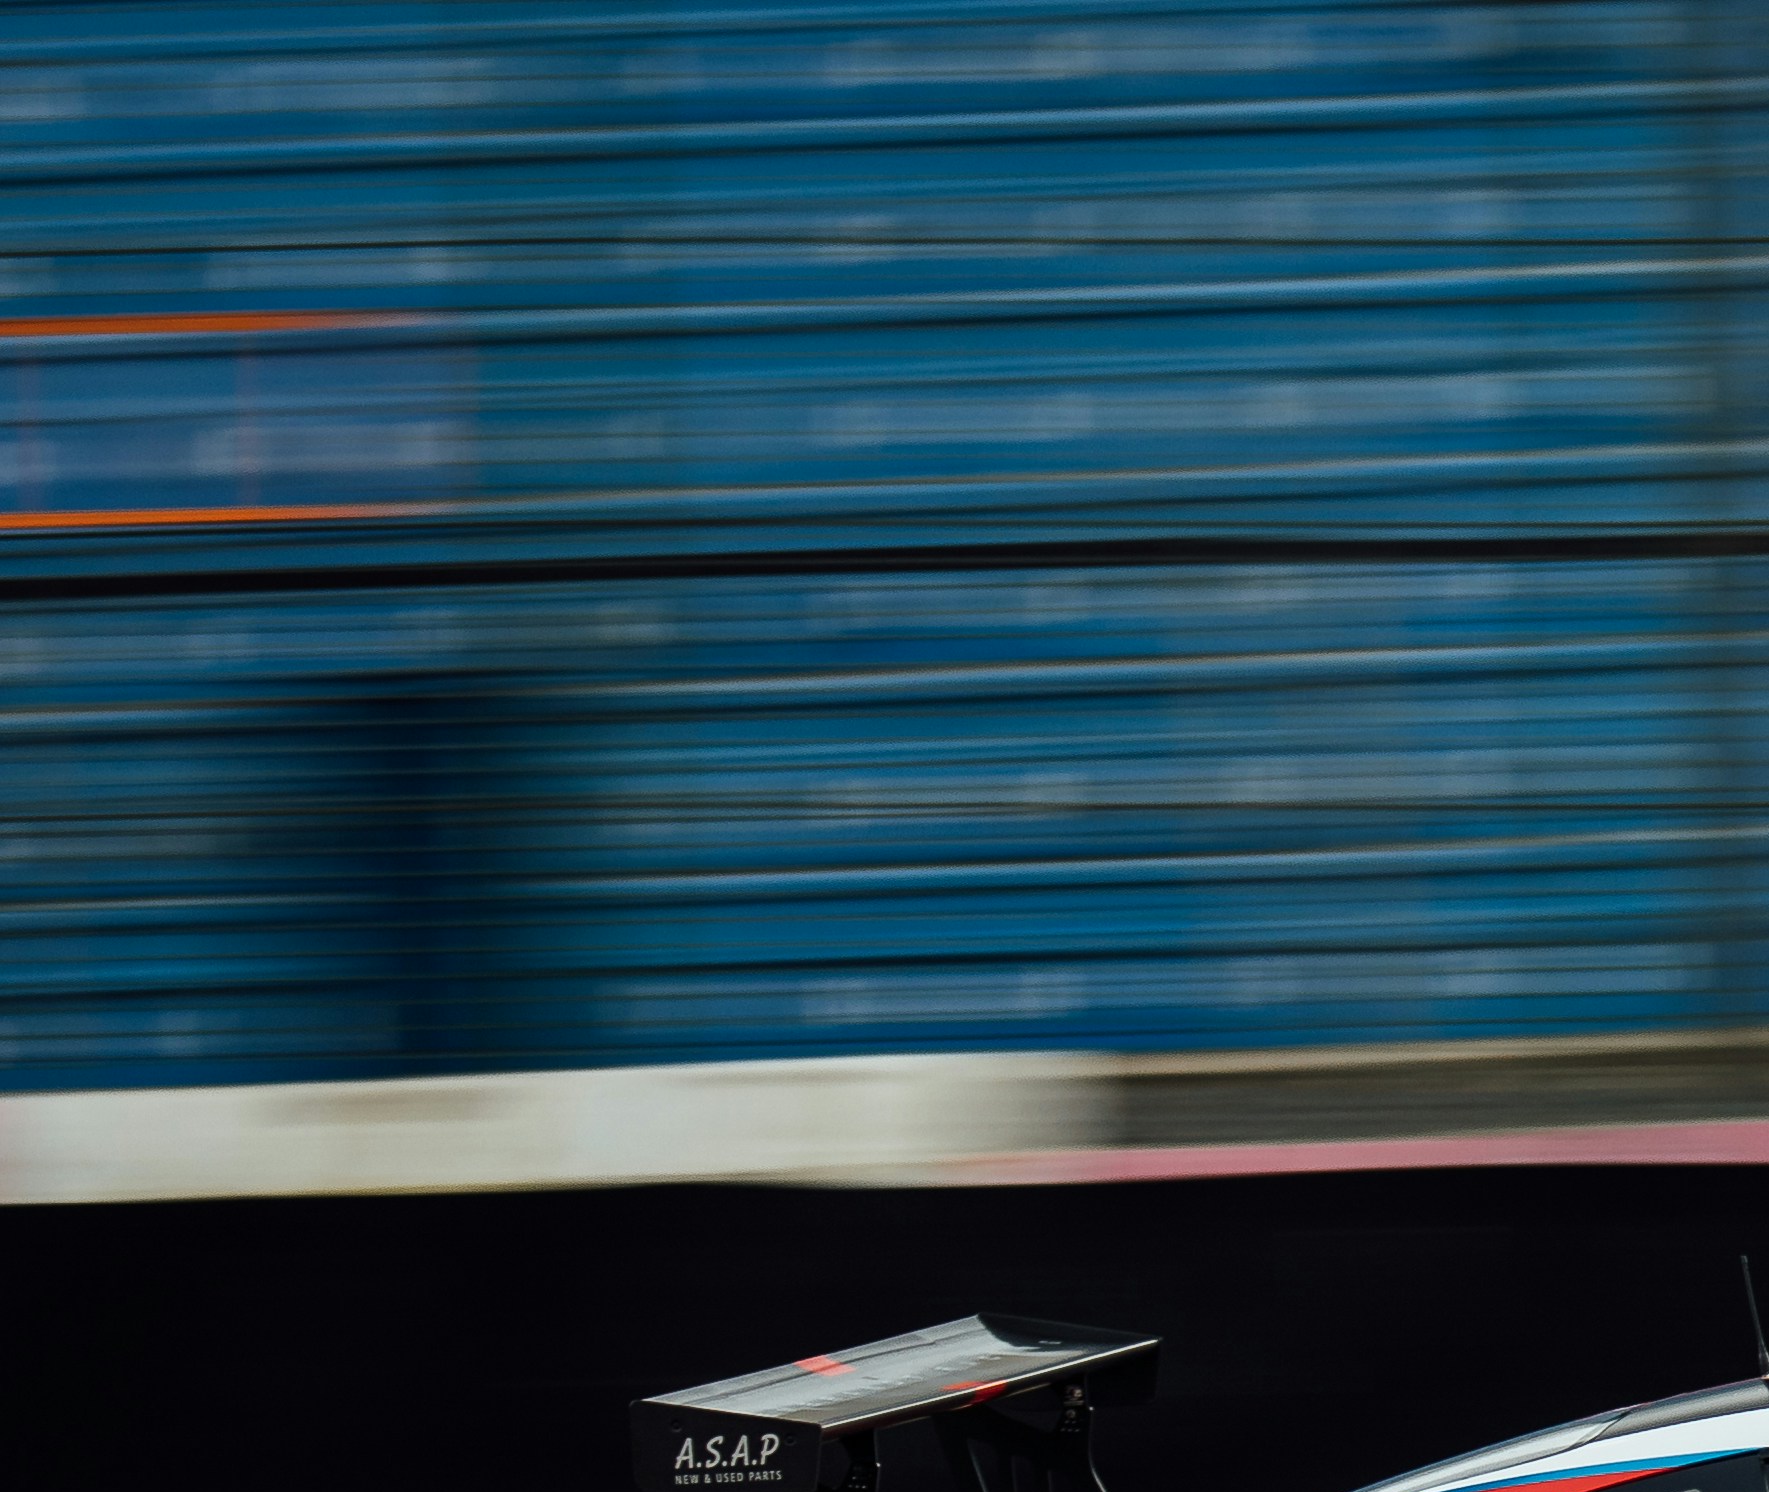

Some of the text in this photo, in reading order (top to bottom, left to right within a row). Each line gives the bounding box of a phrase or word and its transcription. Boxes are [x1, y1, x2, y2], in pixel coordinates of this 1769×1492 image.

[675, 1434, 779, 1469] A.S.A.P
[675, 1474, 699, 1485] NEW
[716, 1472, 744, 1483] USED
[748, 1470, 782, 1481] PARTS
